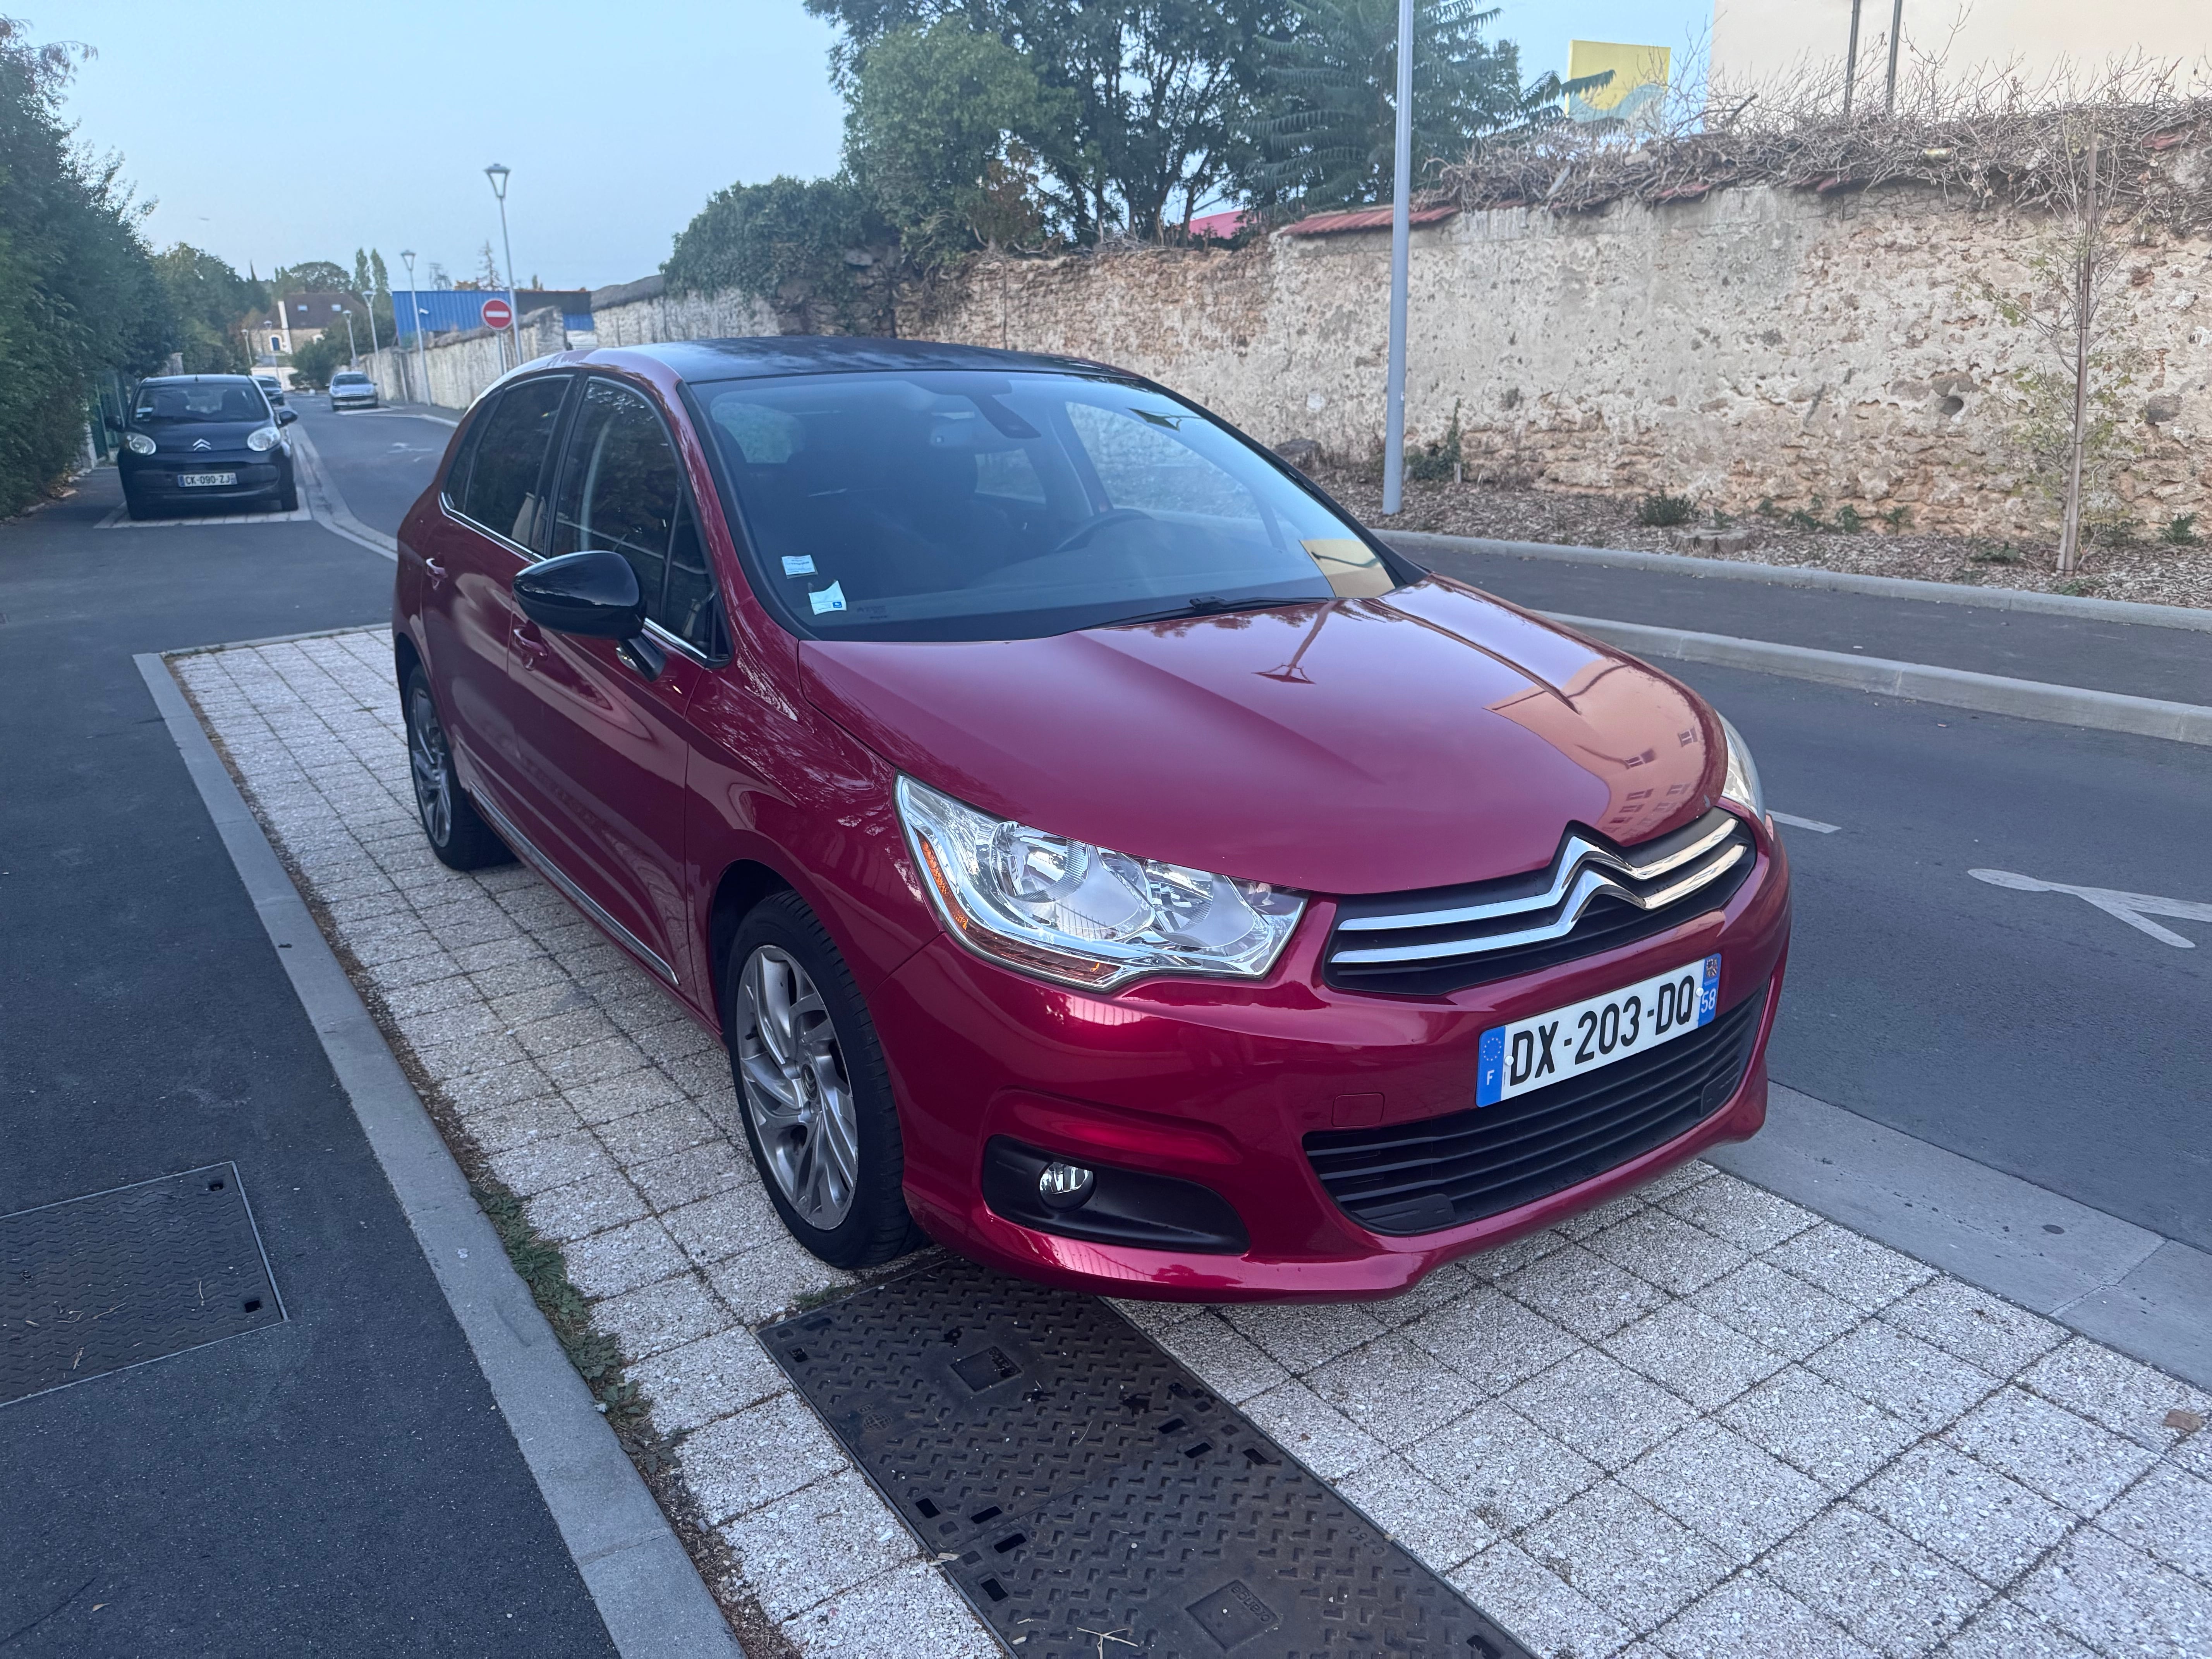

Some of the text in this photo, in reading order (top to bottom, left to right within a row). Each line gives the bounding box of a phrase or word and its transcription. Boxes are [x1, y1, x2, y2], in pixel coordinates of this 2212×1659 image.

[1701, 988, 1717, 1013] 58
[1510, 975, 1694, 1086] DX-203-DQ
[1487, 1069, 1495, 1085] F
[1231, 1586, 1271, 1622] orange
